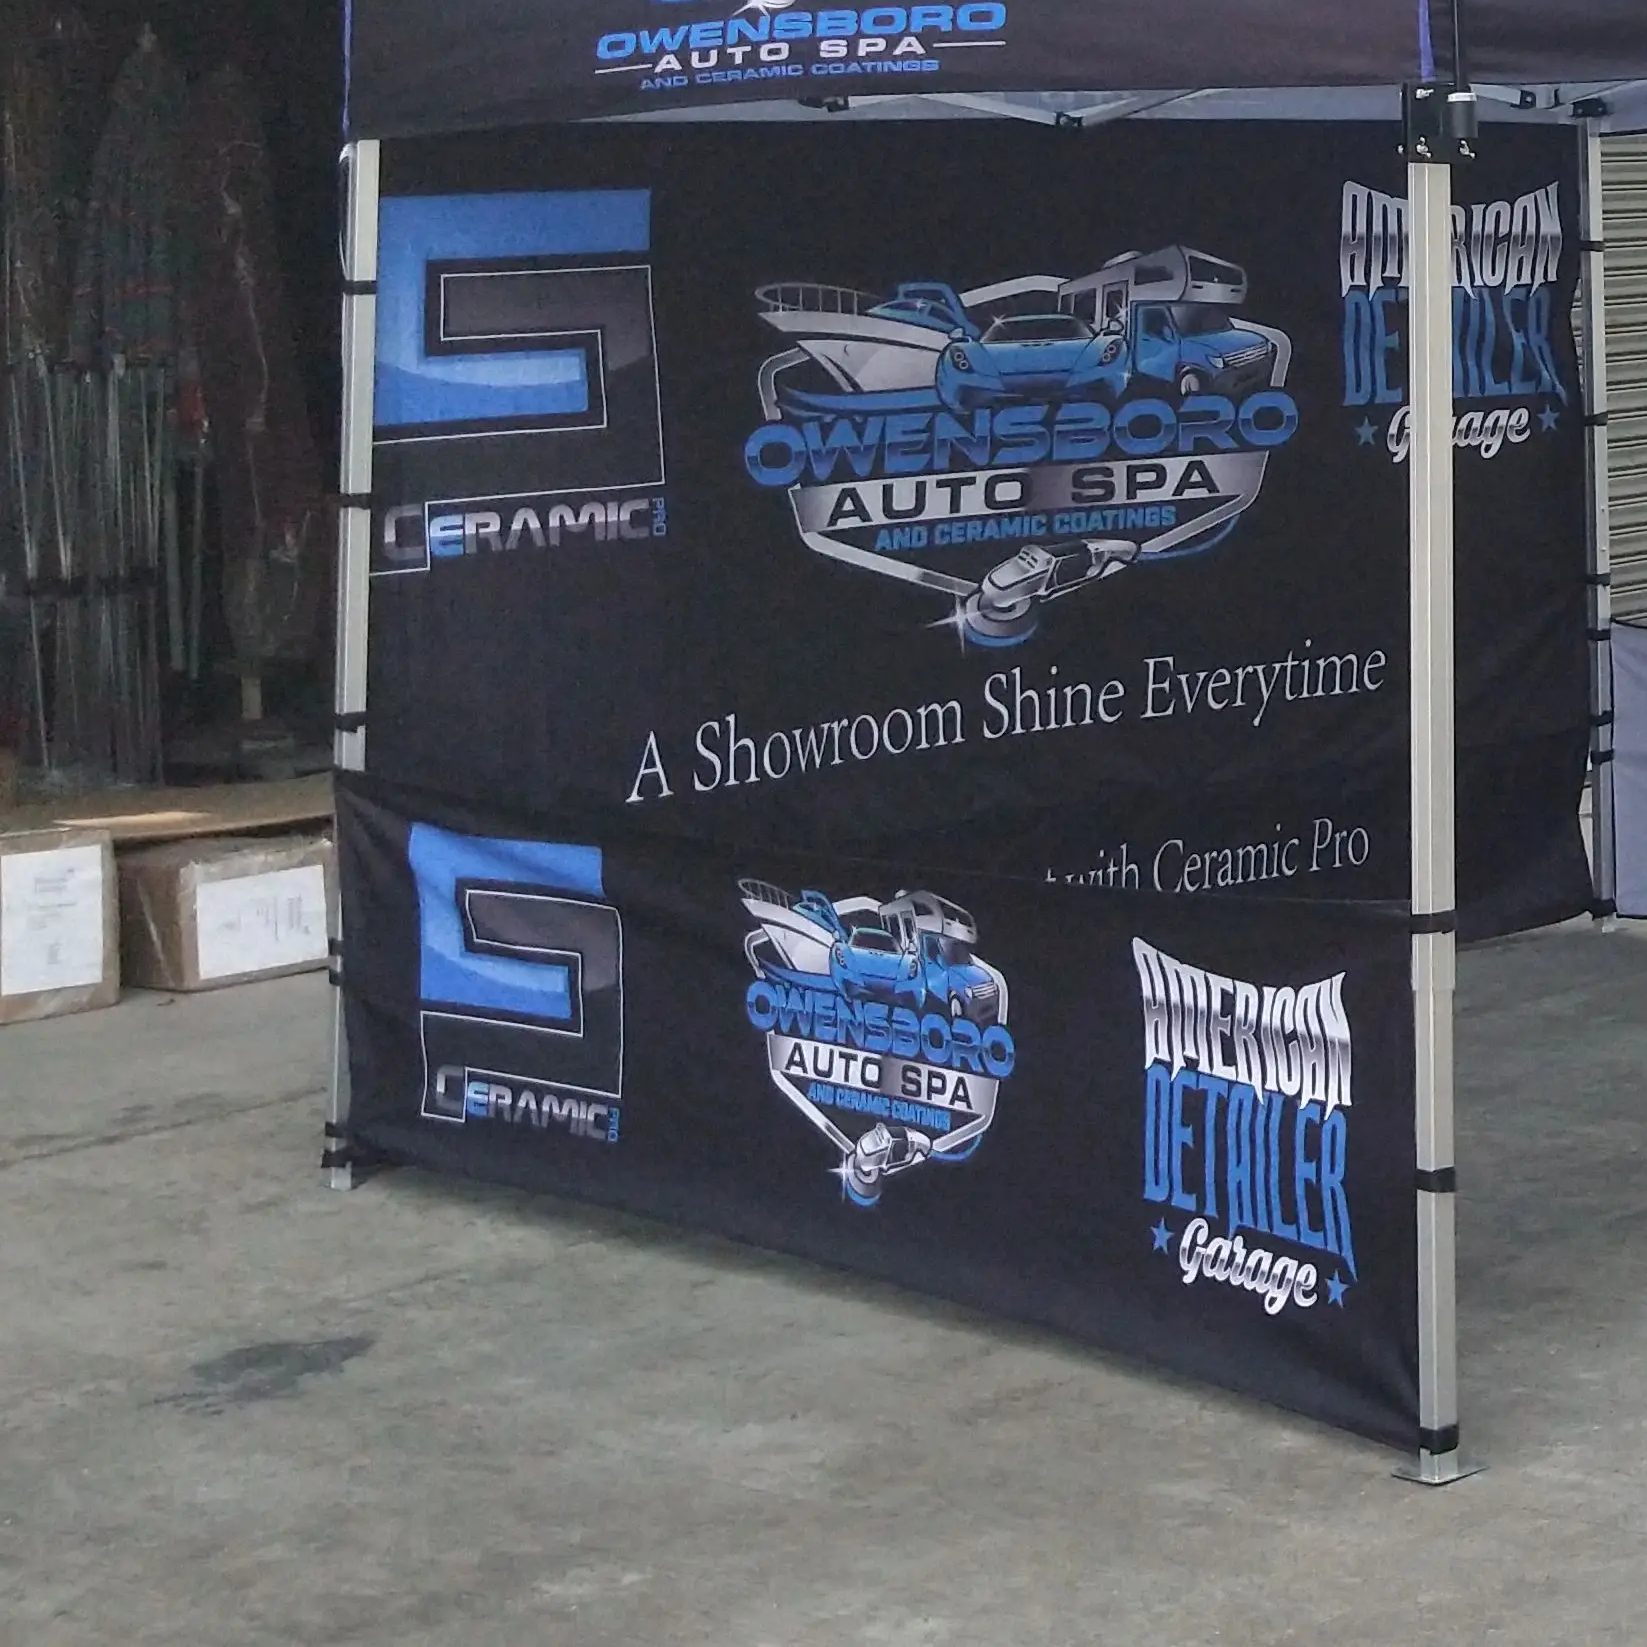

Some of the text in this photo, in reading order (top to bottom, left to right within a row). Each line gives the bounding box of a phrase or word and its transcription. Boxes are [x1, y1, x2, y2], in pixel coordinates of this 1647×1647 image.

[595, 1, 1006, 60] OWENSBORO
[653, 36, 926, 74] AUTO SPA
[639, 59, 941, 91] AND CERAMIC COATINGS
[1339, 179, 1563, 301] AMRICAN
[743, 389, 1299, 487] OWENSBORO
[1386, 404, 1531, 463] Gage
[383, 496, 650, 561] CERAMIC
[827, 459, 1221, 528] AUTO SPA
[875, 504, 1176, 553] AND CERAMIC COATINGS
[624, 638, 1387, 805] A Showroom Shine Everytime
[1153, 823, 1300, 892] Ceramic
[1308, 817, 1369, 872] Pro
[746, 980, 1015, 1077] OWENSBORO
[1131, 936, 1352, 1121] AMERICAN
[436, 1064, 609, 1141] CERAMIC
[785, 1042, 973, 1110] AUTO SPA
[1144, 1062, 1357, 1282] DETAILER
[1179, 1217, 1318, 1315] Garage
